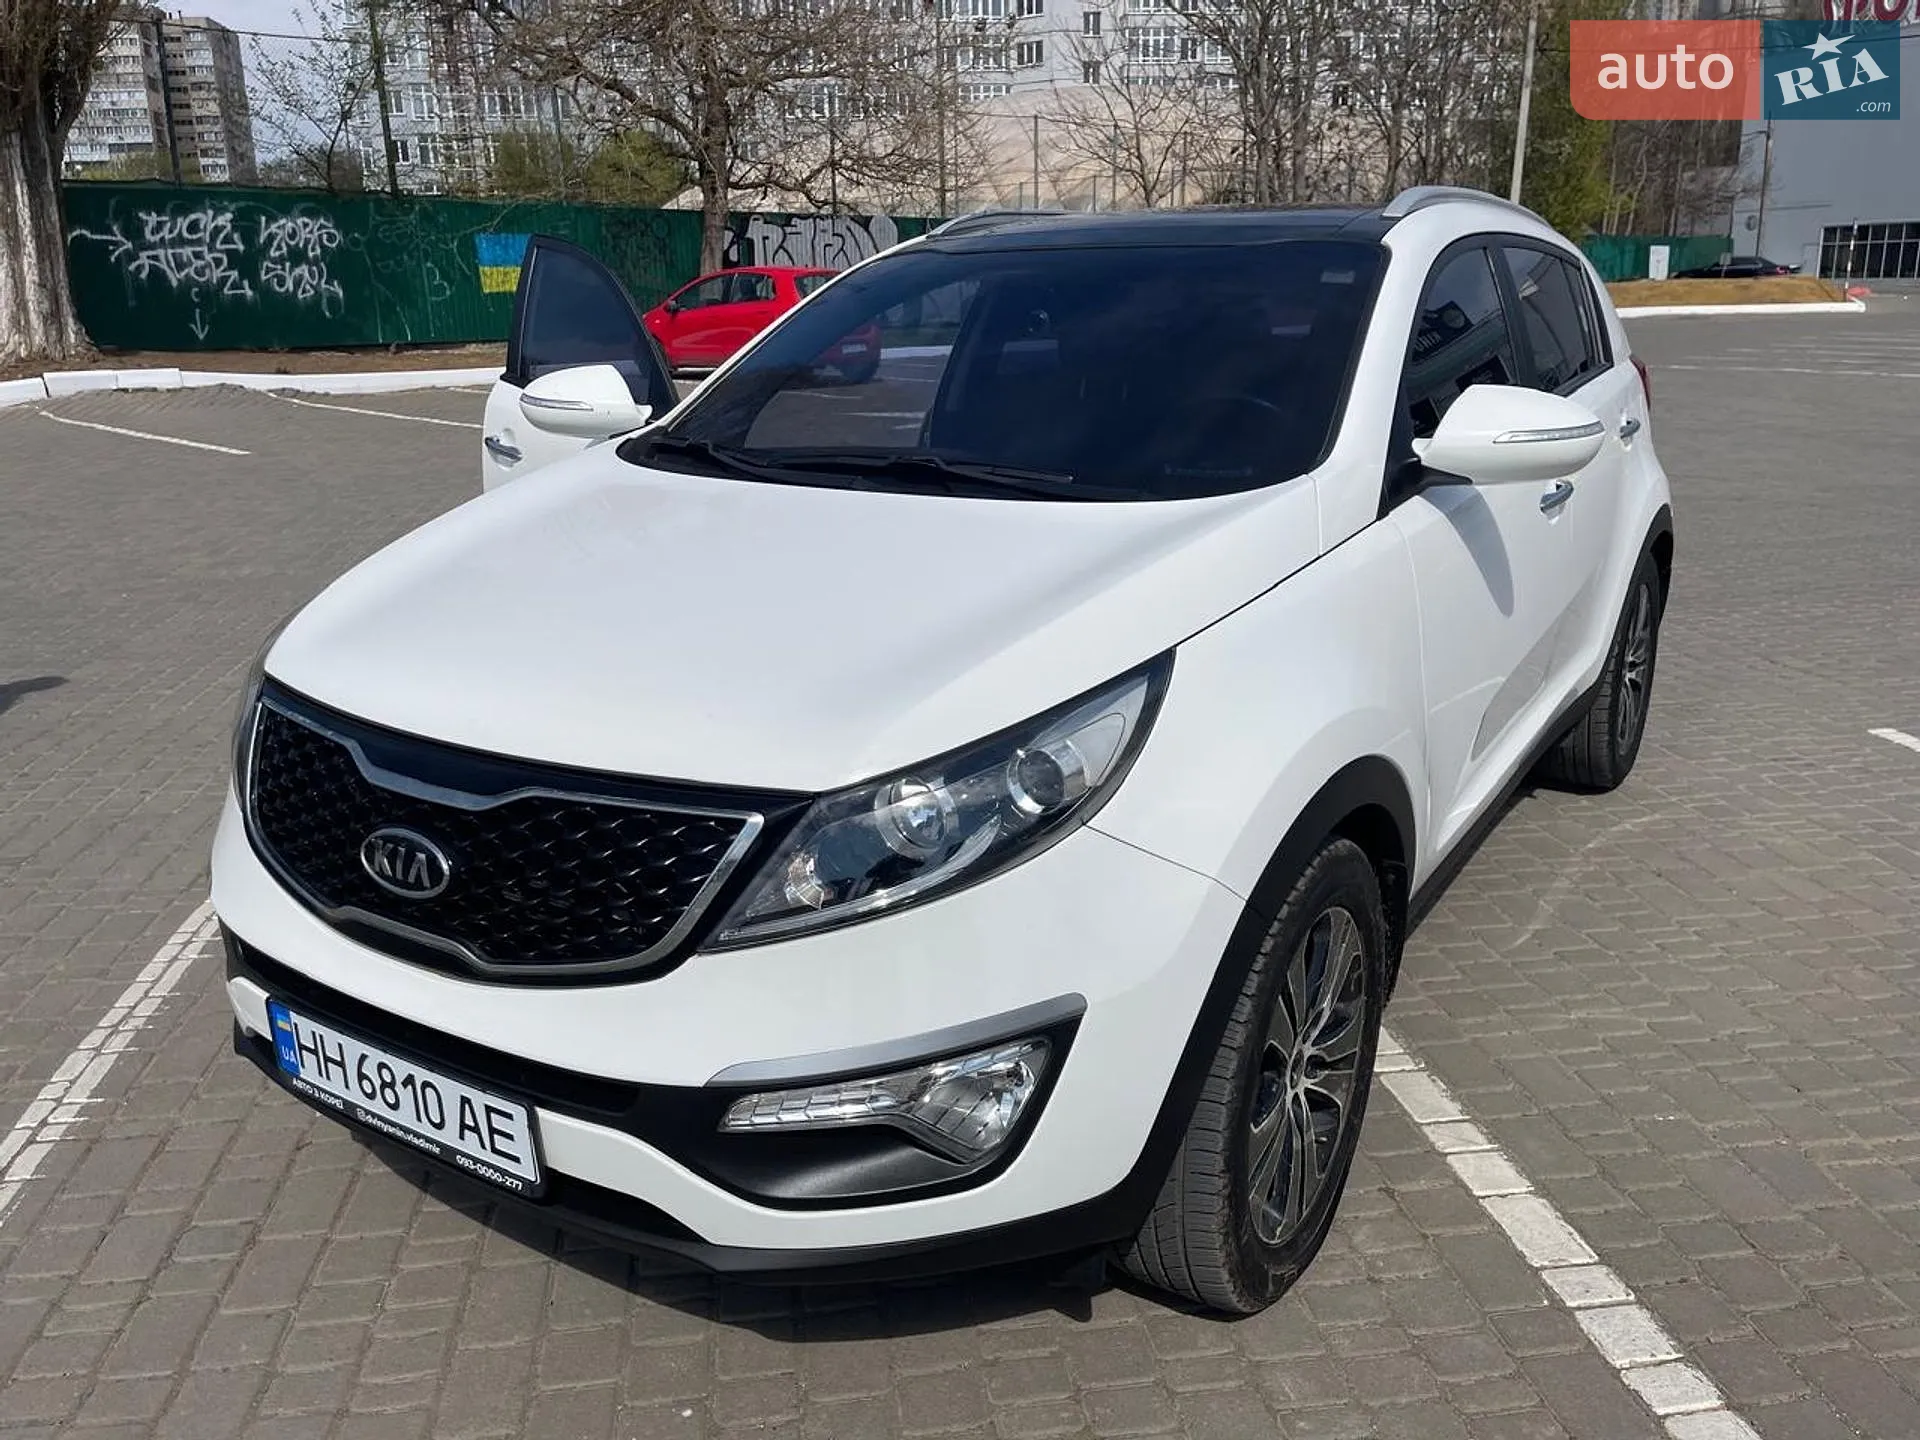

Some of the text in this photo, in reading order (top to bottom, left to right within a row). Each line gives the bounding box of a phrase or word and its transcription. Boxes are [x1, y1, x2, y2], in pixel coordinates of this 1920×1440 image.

[370, 838, 431, 889] KIA
[282, 1045, 297, 1065] UA
[293, 1022, 522, 1165] HH 6810 AE
